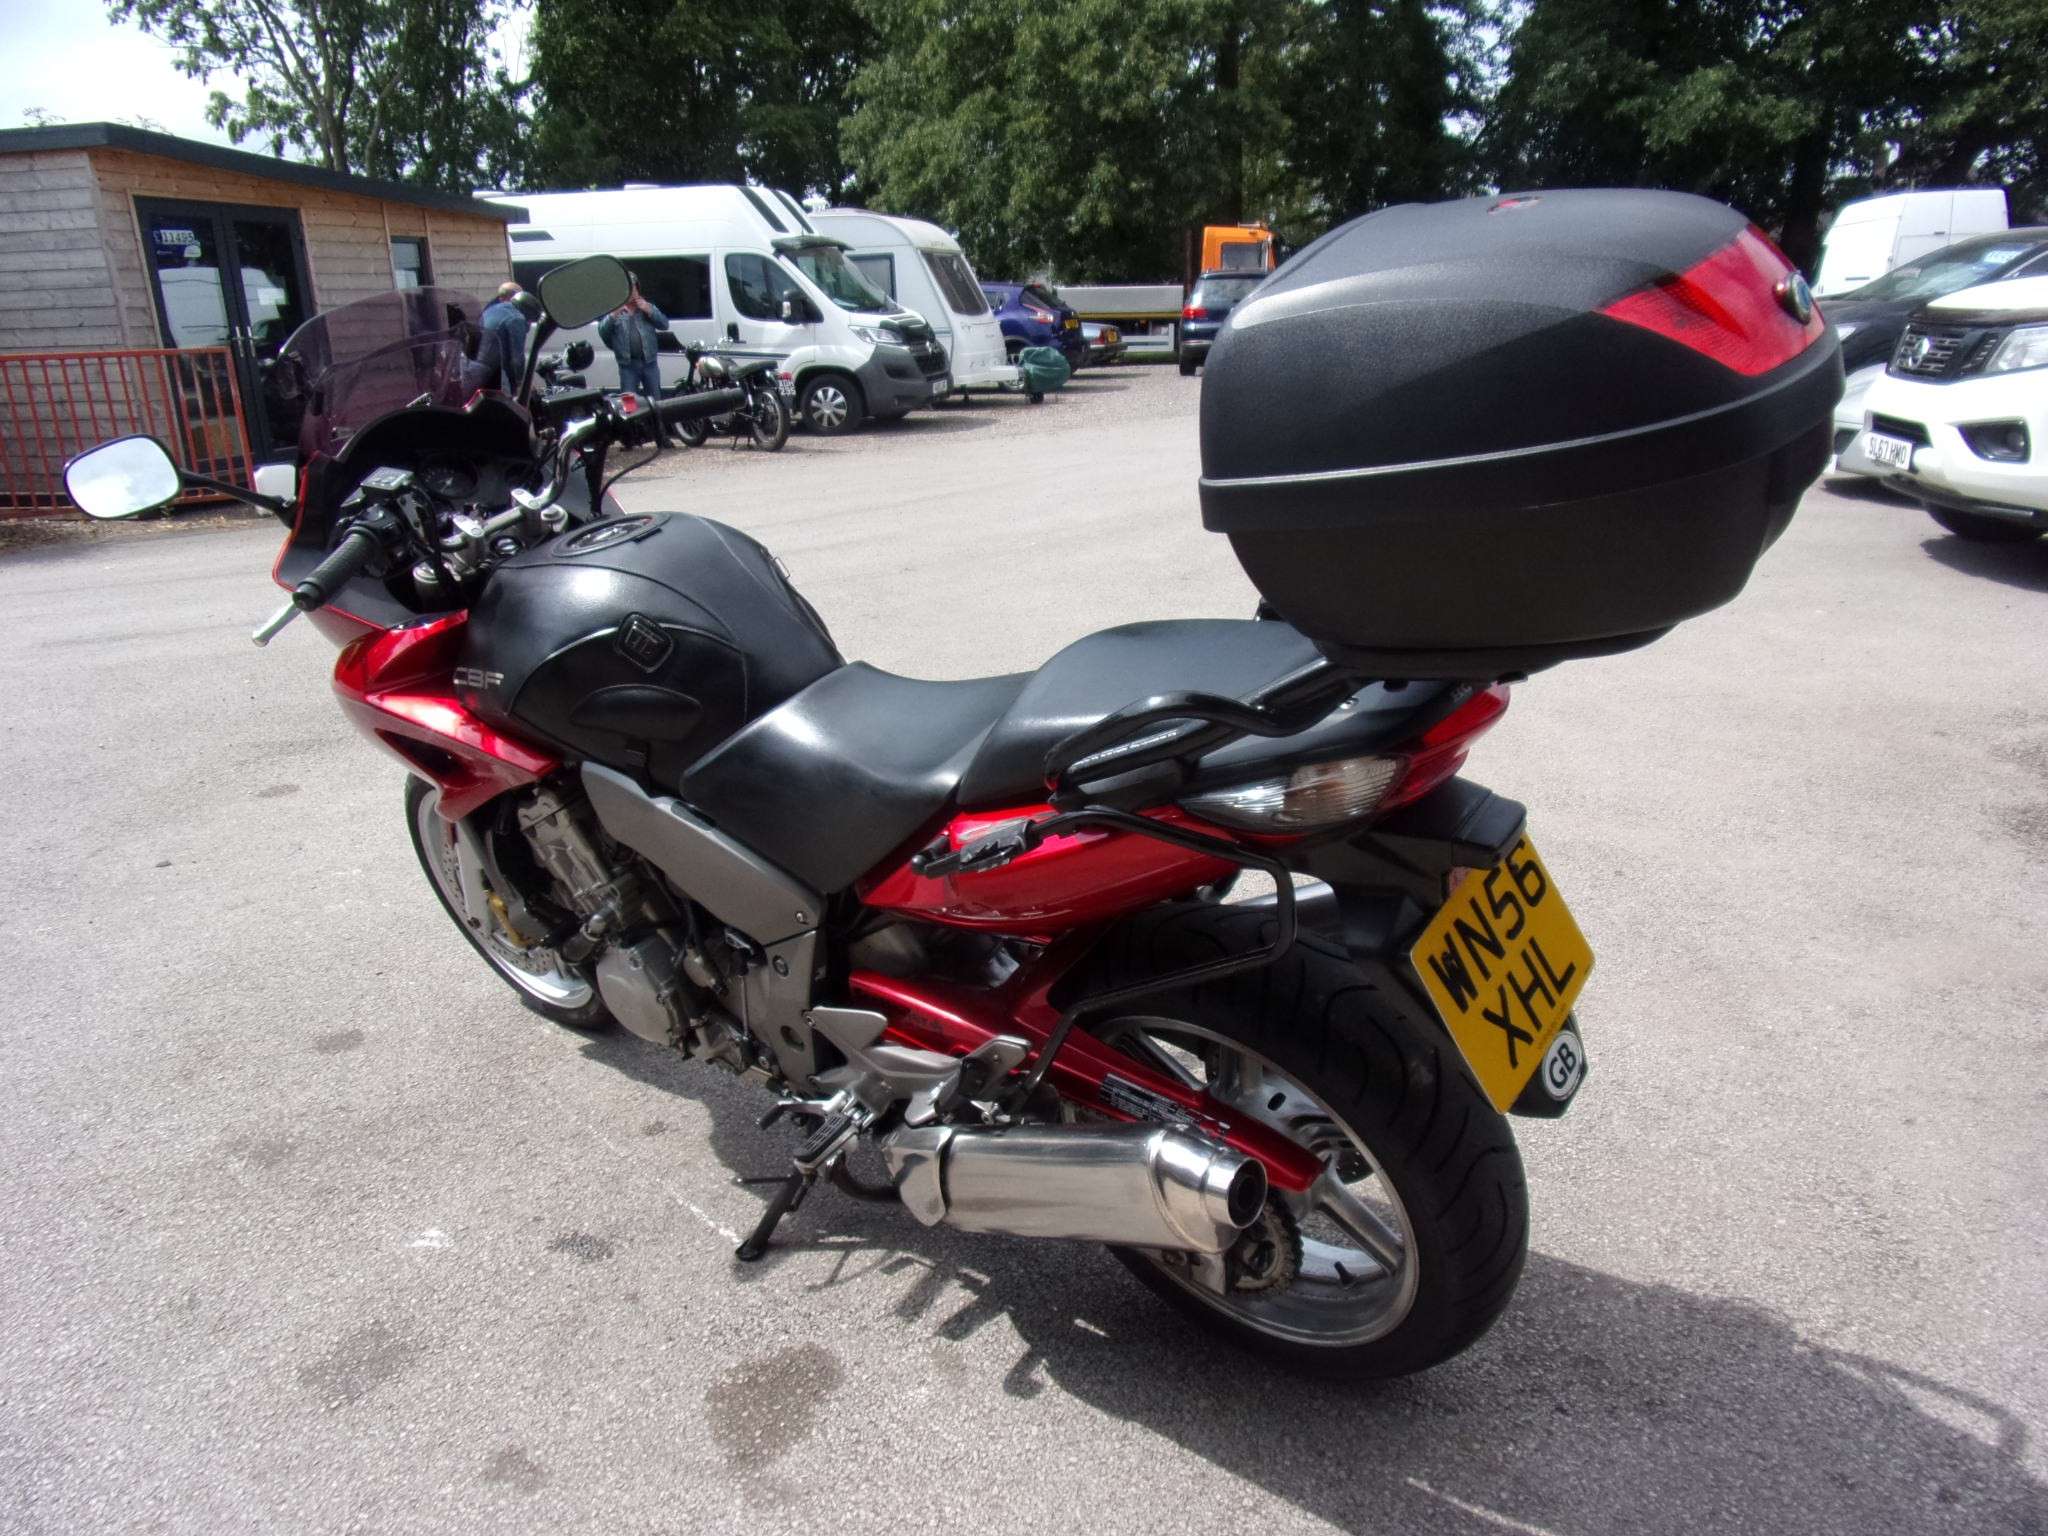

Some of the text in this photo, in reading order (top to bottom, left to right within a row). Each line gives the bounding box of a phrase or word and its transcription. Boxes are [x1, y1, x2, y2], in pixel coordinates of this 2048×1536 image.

[1869, 436, 1889, 459] SL67
[453, 667, 504, 689] CBF
[1427, 838, 1547, 1014] WN56
[1482, 937, 1576, 1070] XHL
[1549, 1042, 1576, 1090] GB
